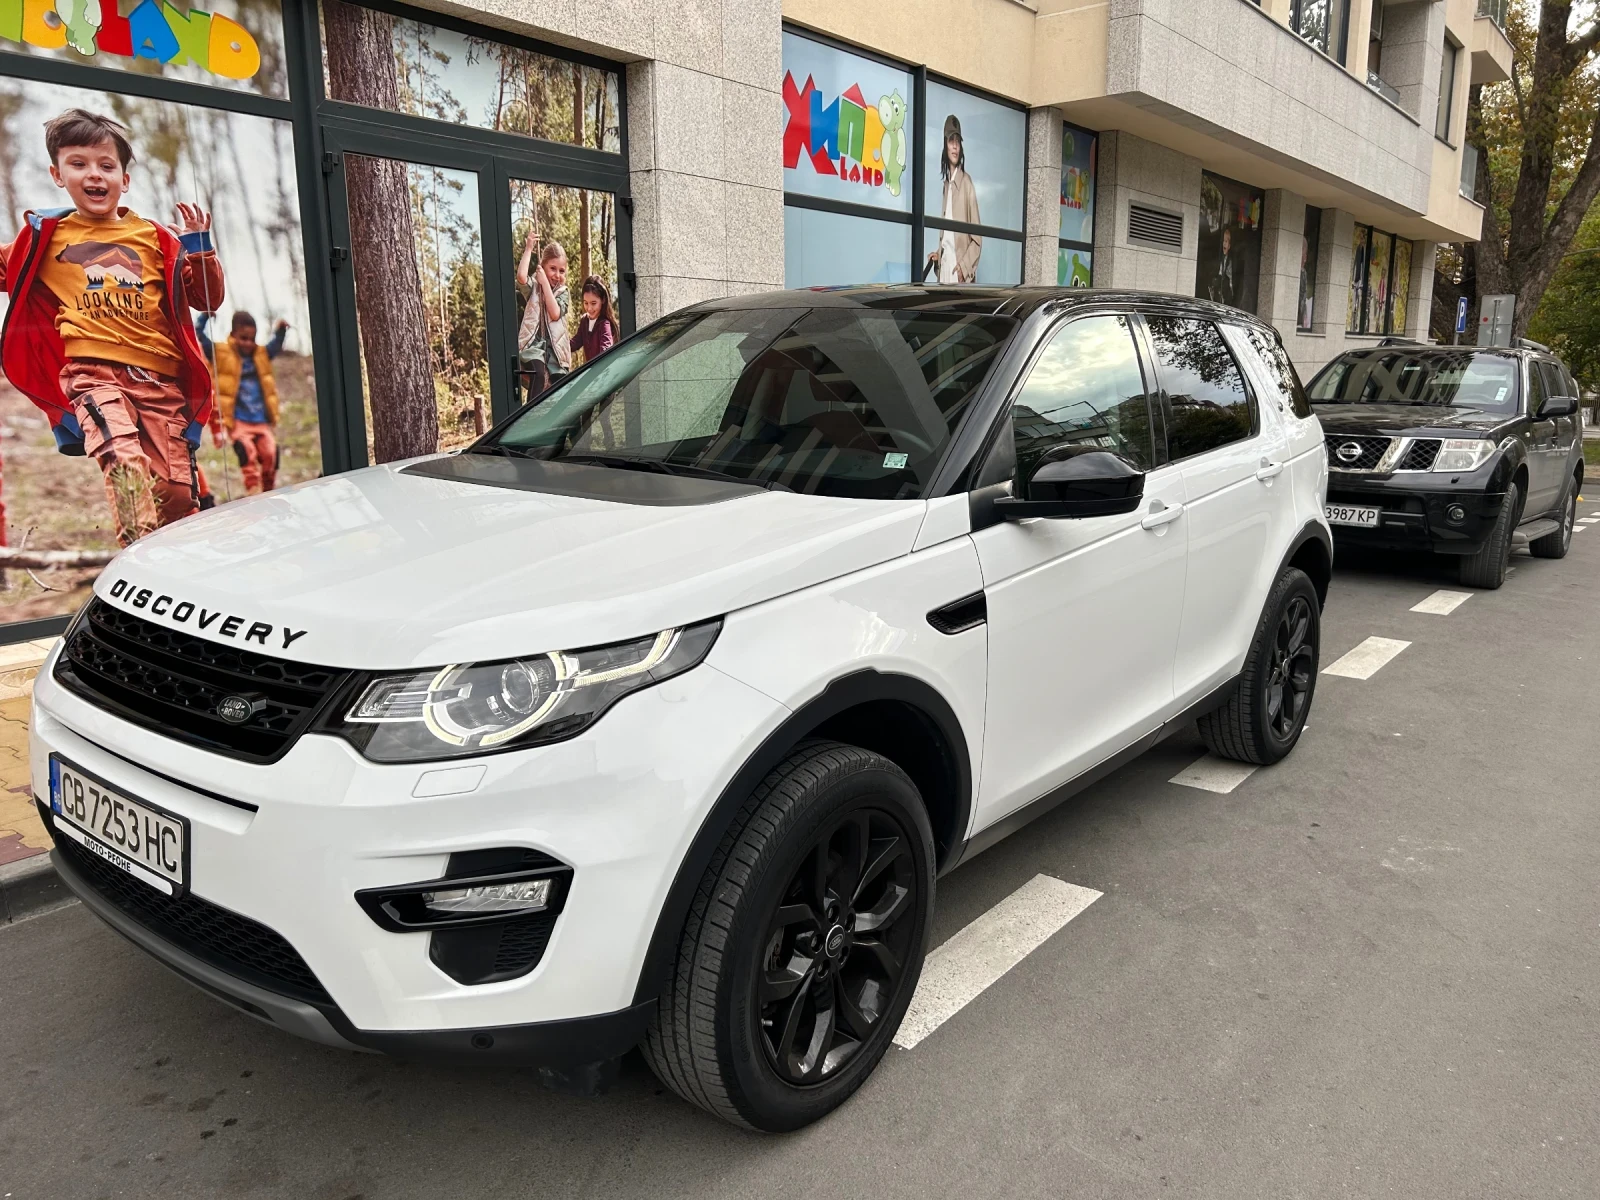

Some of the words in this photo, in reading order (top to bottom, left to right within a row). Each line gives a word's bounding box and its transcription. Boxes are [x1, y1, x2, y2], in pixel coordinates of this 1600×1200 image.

[840, 156, 884, 187] LAND
[75, 291, 143, 311] LOOKING
[90, 310, 101, 320] AN
[1325, 507, 1356, 521] 3987
[1357, 509, 1376, 523] KP
[110, 578, 308, 649] DISCOVERY
[222, 707, 245, 720] ROVER
[224, 698, 243, 710] LAND
[62, 772, 86, 822] CB
[88, 786, 140, 853] 7253
[144, 815, 177, 873] HC
[83, 836, 132, 873] MOTO-PFOHE
